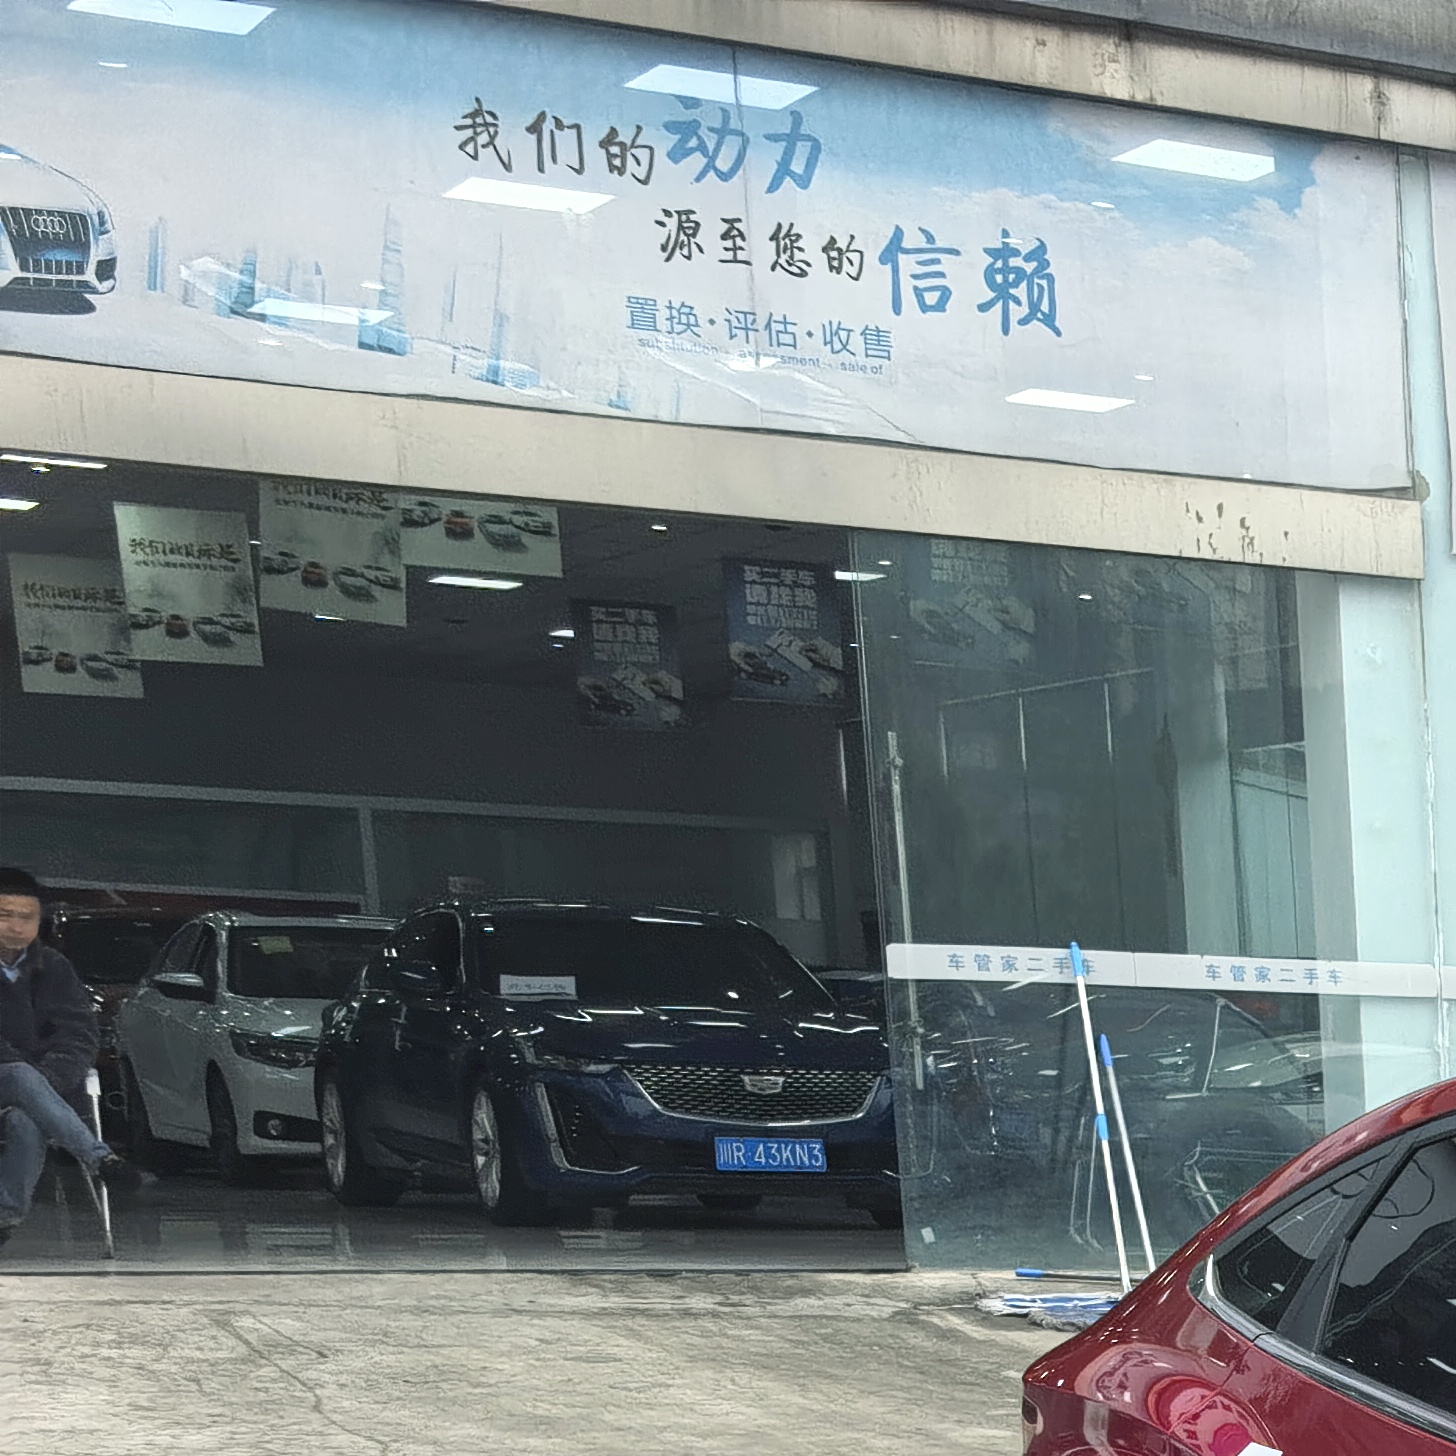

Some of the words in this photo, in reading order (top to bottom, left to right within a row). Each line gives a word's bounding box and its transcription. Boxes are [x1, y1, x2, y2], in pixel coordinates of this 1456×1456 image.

[453, 96, 822, 194] 我们的动力
[654, 206, 1062, 338] 源至您的信赖
[947, 953, 1096, 978] 车管家二手车
[1205, 963, 1344, 987] 车管家二手车
